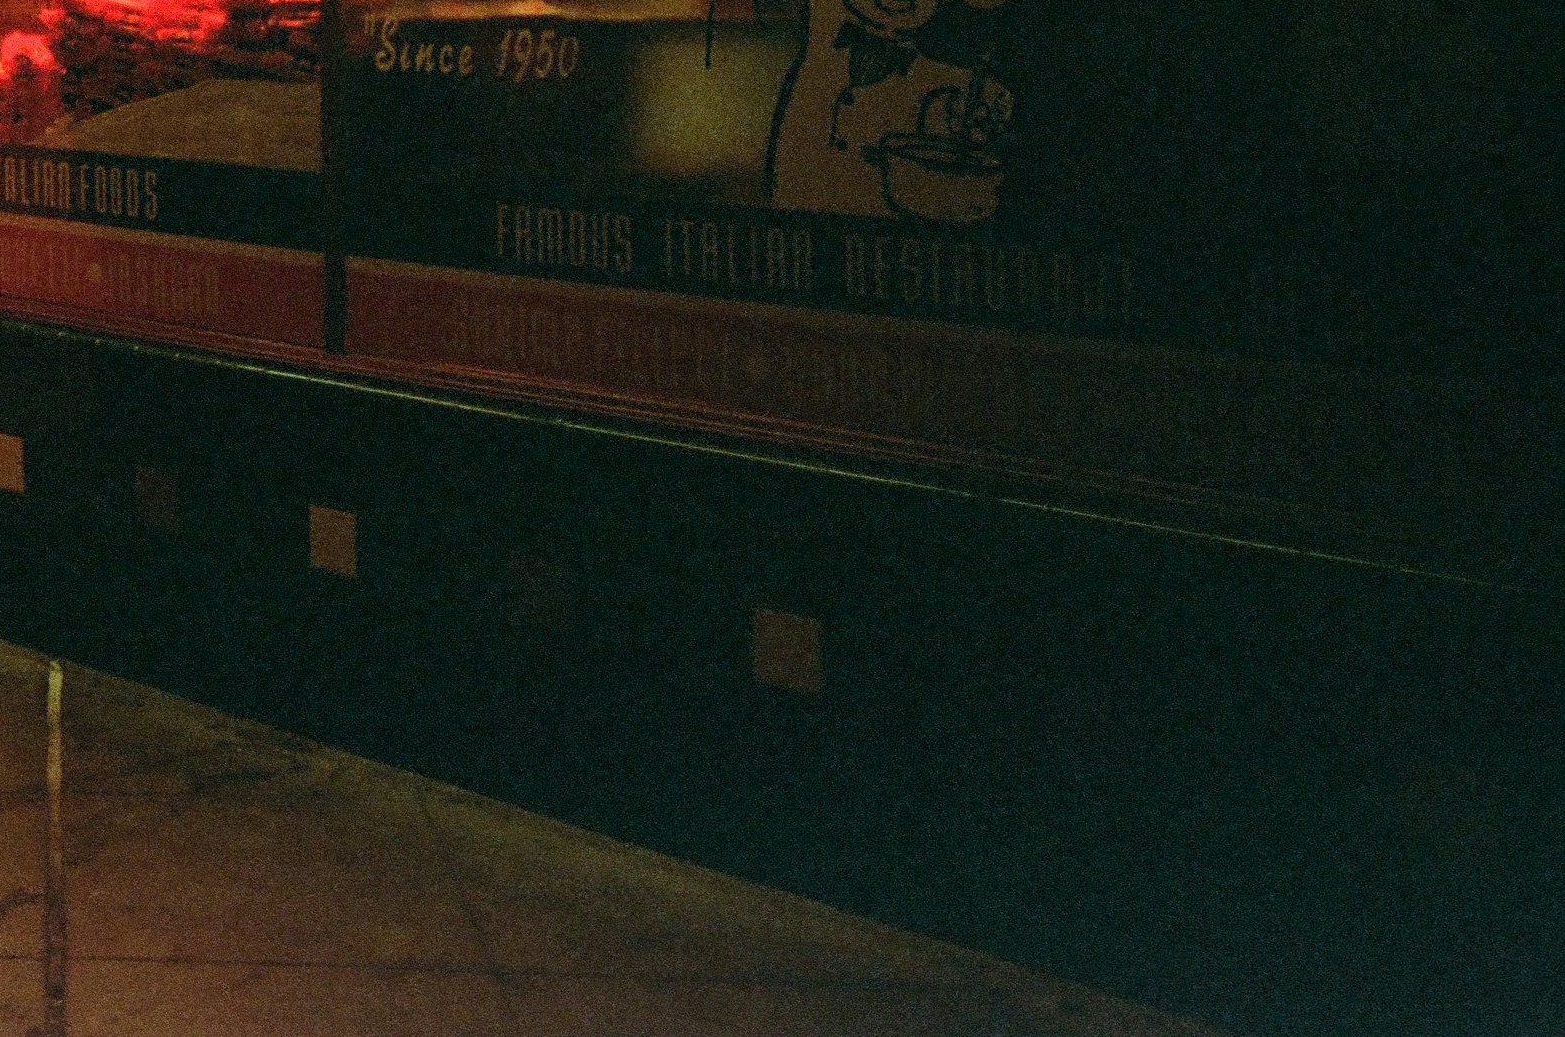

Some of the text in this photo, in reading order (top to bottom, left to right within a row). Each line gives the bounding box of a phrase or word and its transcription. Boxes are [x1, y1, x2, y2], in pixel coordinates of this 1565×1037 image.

[495, 26, 581, 85] 1950
[79, 165, 160, 221] FOODS
[495, 202, 634, 274] FAMOUS
[663, 218, 813, 292] ITALIAN
